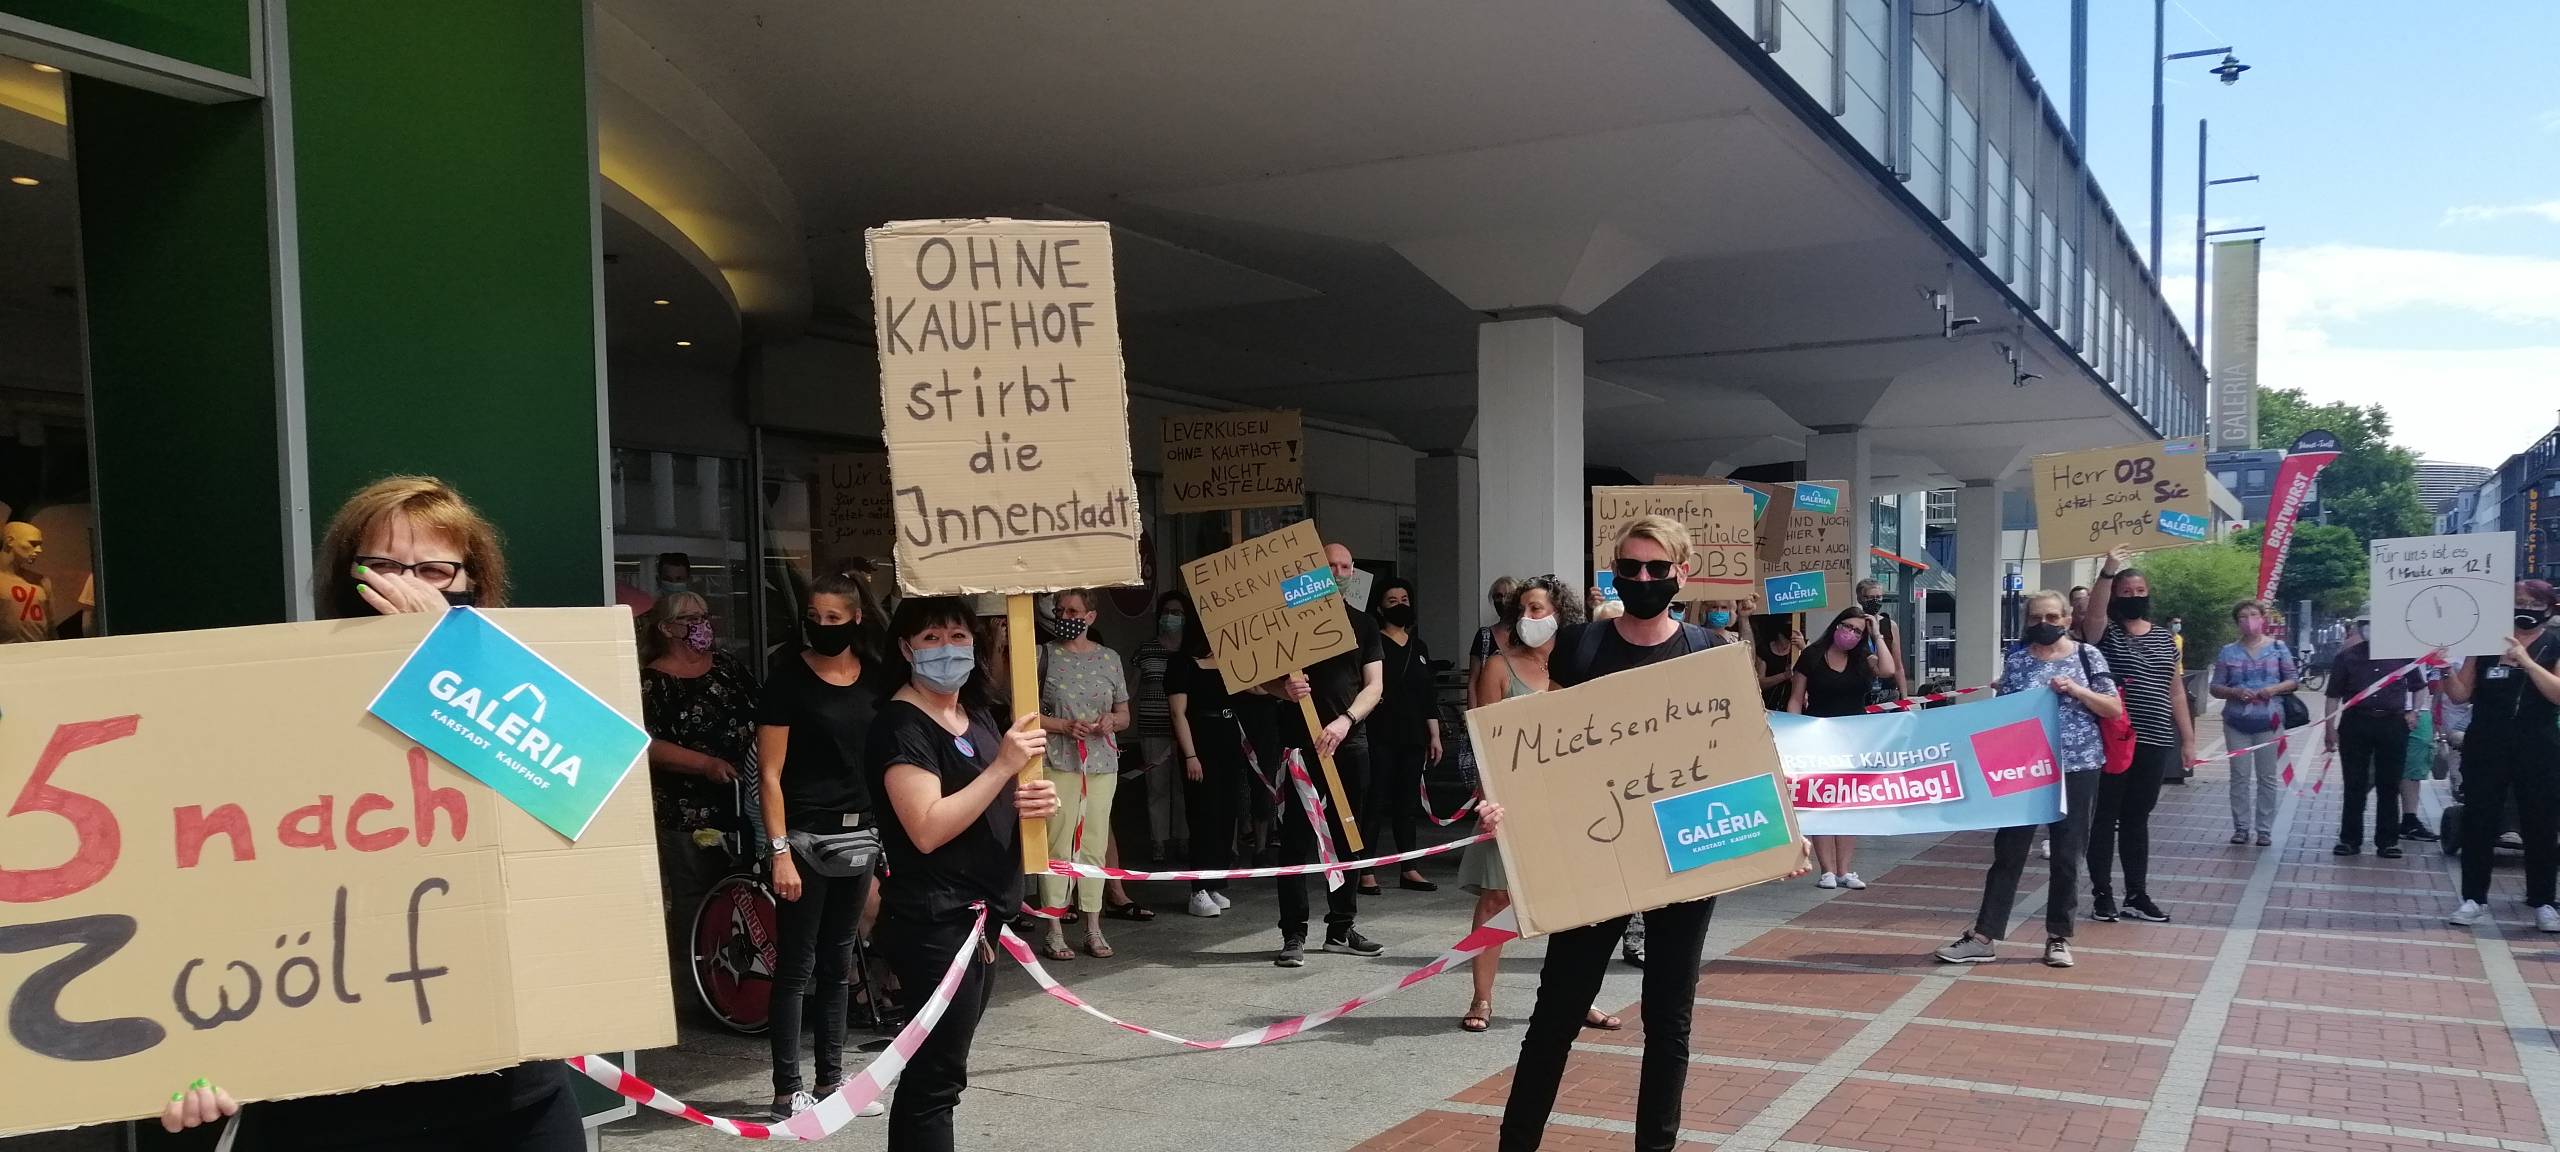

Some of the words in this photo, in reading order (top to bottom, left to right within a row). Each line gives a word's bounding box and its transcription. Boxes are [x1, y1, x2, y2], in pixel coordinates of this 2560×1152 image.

[916, 236, 1089, 291] OHNE
[886, 296, 1095, 355] KAUFHOF
[905, 362, 1076, 422] stirbt
[2222, 362, 2249, 442] GALERIA
[1163, 420, 1269, 443] LEVERKUSEN
[969, 430, 1042, 474] die
[1167, 447, 1203, 461] OHNE
[831, 462, 872, 489] Wir
[1211, 463, 1267, 482] NICHT
[2053, 464, 2107, 491] Herr
[2114, 457, 2155, 485] OB
[1173, 477, 1304, 501] VORSTELLBAR
[1800, 494, 1831, 505] GALERIA
[2055, 493, 2097, 517] jetzt
[2154, 480, 2189, 503] Sie
[1599, 497, 1640, 519] Wir
[1645, 498, 1713, 519] kämpfen
[1789, 516, 1814, 528] IND
[1821, 515, 1849, 527] NOCH
[2266, 471, 2309, 549] BRATWURST
[1595, 525, 1616, 547] fü
[2089, 510, 2153, 542] gefragt
[2159, 518, 2206, 536] GALERIA
[1194, 531, 1299, 585] EINFACH
[1686, 550, 1748, 578] OBS
[1782, 544, 1820, 556] OLLEN
[1825, 544, 1849, 553] AUCH
[2374, 544, 2399, 563] Für
[2404, 550, 2428, 560] uns
[2432, 544, 2447, 559] ist
[2452, 547, 2470, 558] es
[1763, 561, 1792, 573] HIER
[2385, 566, 2394, 580] 1
[1199, 552, 1320, 616] ABSERVIERT
[1284, 578, 1335, 602] GALERIA
[1775, 588, 1819, 602] GALERIA
[2014, 577, 2022, 589] P
[1219, 605, 1290, 659] NICHT
[1297, 596, 1333, 621] mit
[1230, 619, 1343, 684] UNS
[428, 670, 583, 788] GALERIA
[430, 709, 491, 750] KARSTADT
[495, 750, 551, 791] KAUFHOF
[1783, 752, 1854, 770] RSTADT
[1860, 742, 1952, 769] KAUFHOF
[1988, 764, 2026, 782] ver
[2030, 759, 2053, 778] di
[1807, 770, 1952, 804] Kahlschlag!
[0, 714, 143, 903] 5
[173, 747, 469, 869] nach
[1677, 810, 1769, 845] GALERIA
[1692, 840, 1726, 853] KARSTADT
[1730, 831, 1761, 844] KAUFHOF
